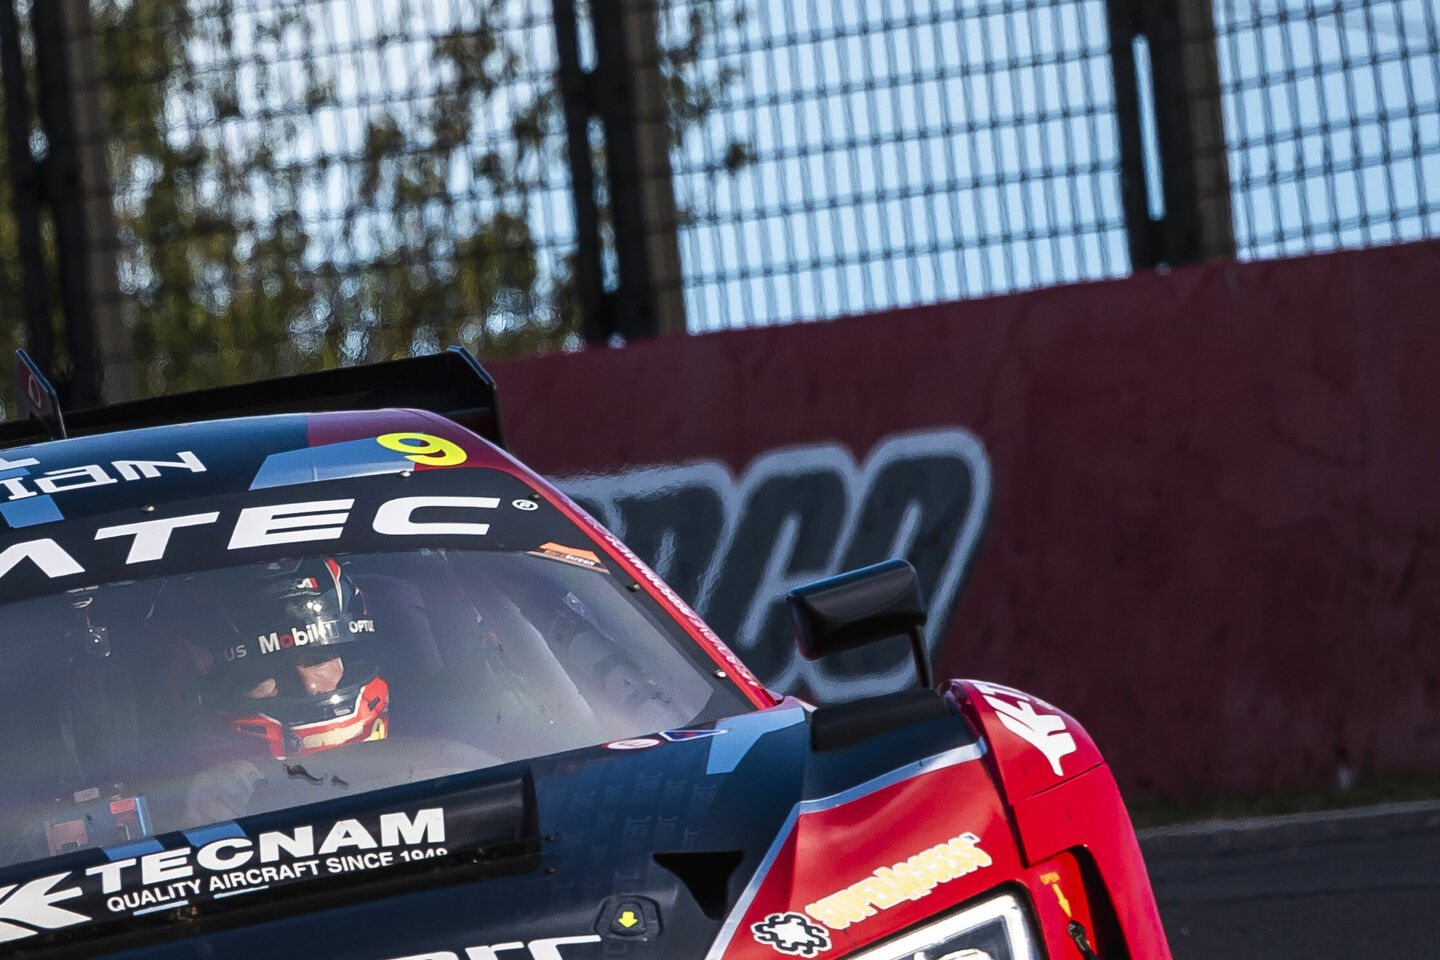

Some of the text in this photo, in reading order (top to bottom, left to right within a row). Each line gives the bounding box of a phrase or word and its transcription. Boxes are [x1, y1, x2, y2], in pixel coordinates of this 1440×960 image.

[86, 807, 446, 893] TECNAM
[107, 878, 203, 912] QUALITY
[207, 860, 320, 894] AIRCRAFT
[326, 850, 394, 874] SINCE
